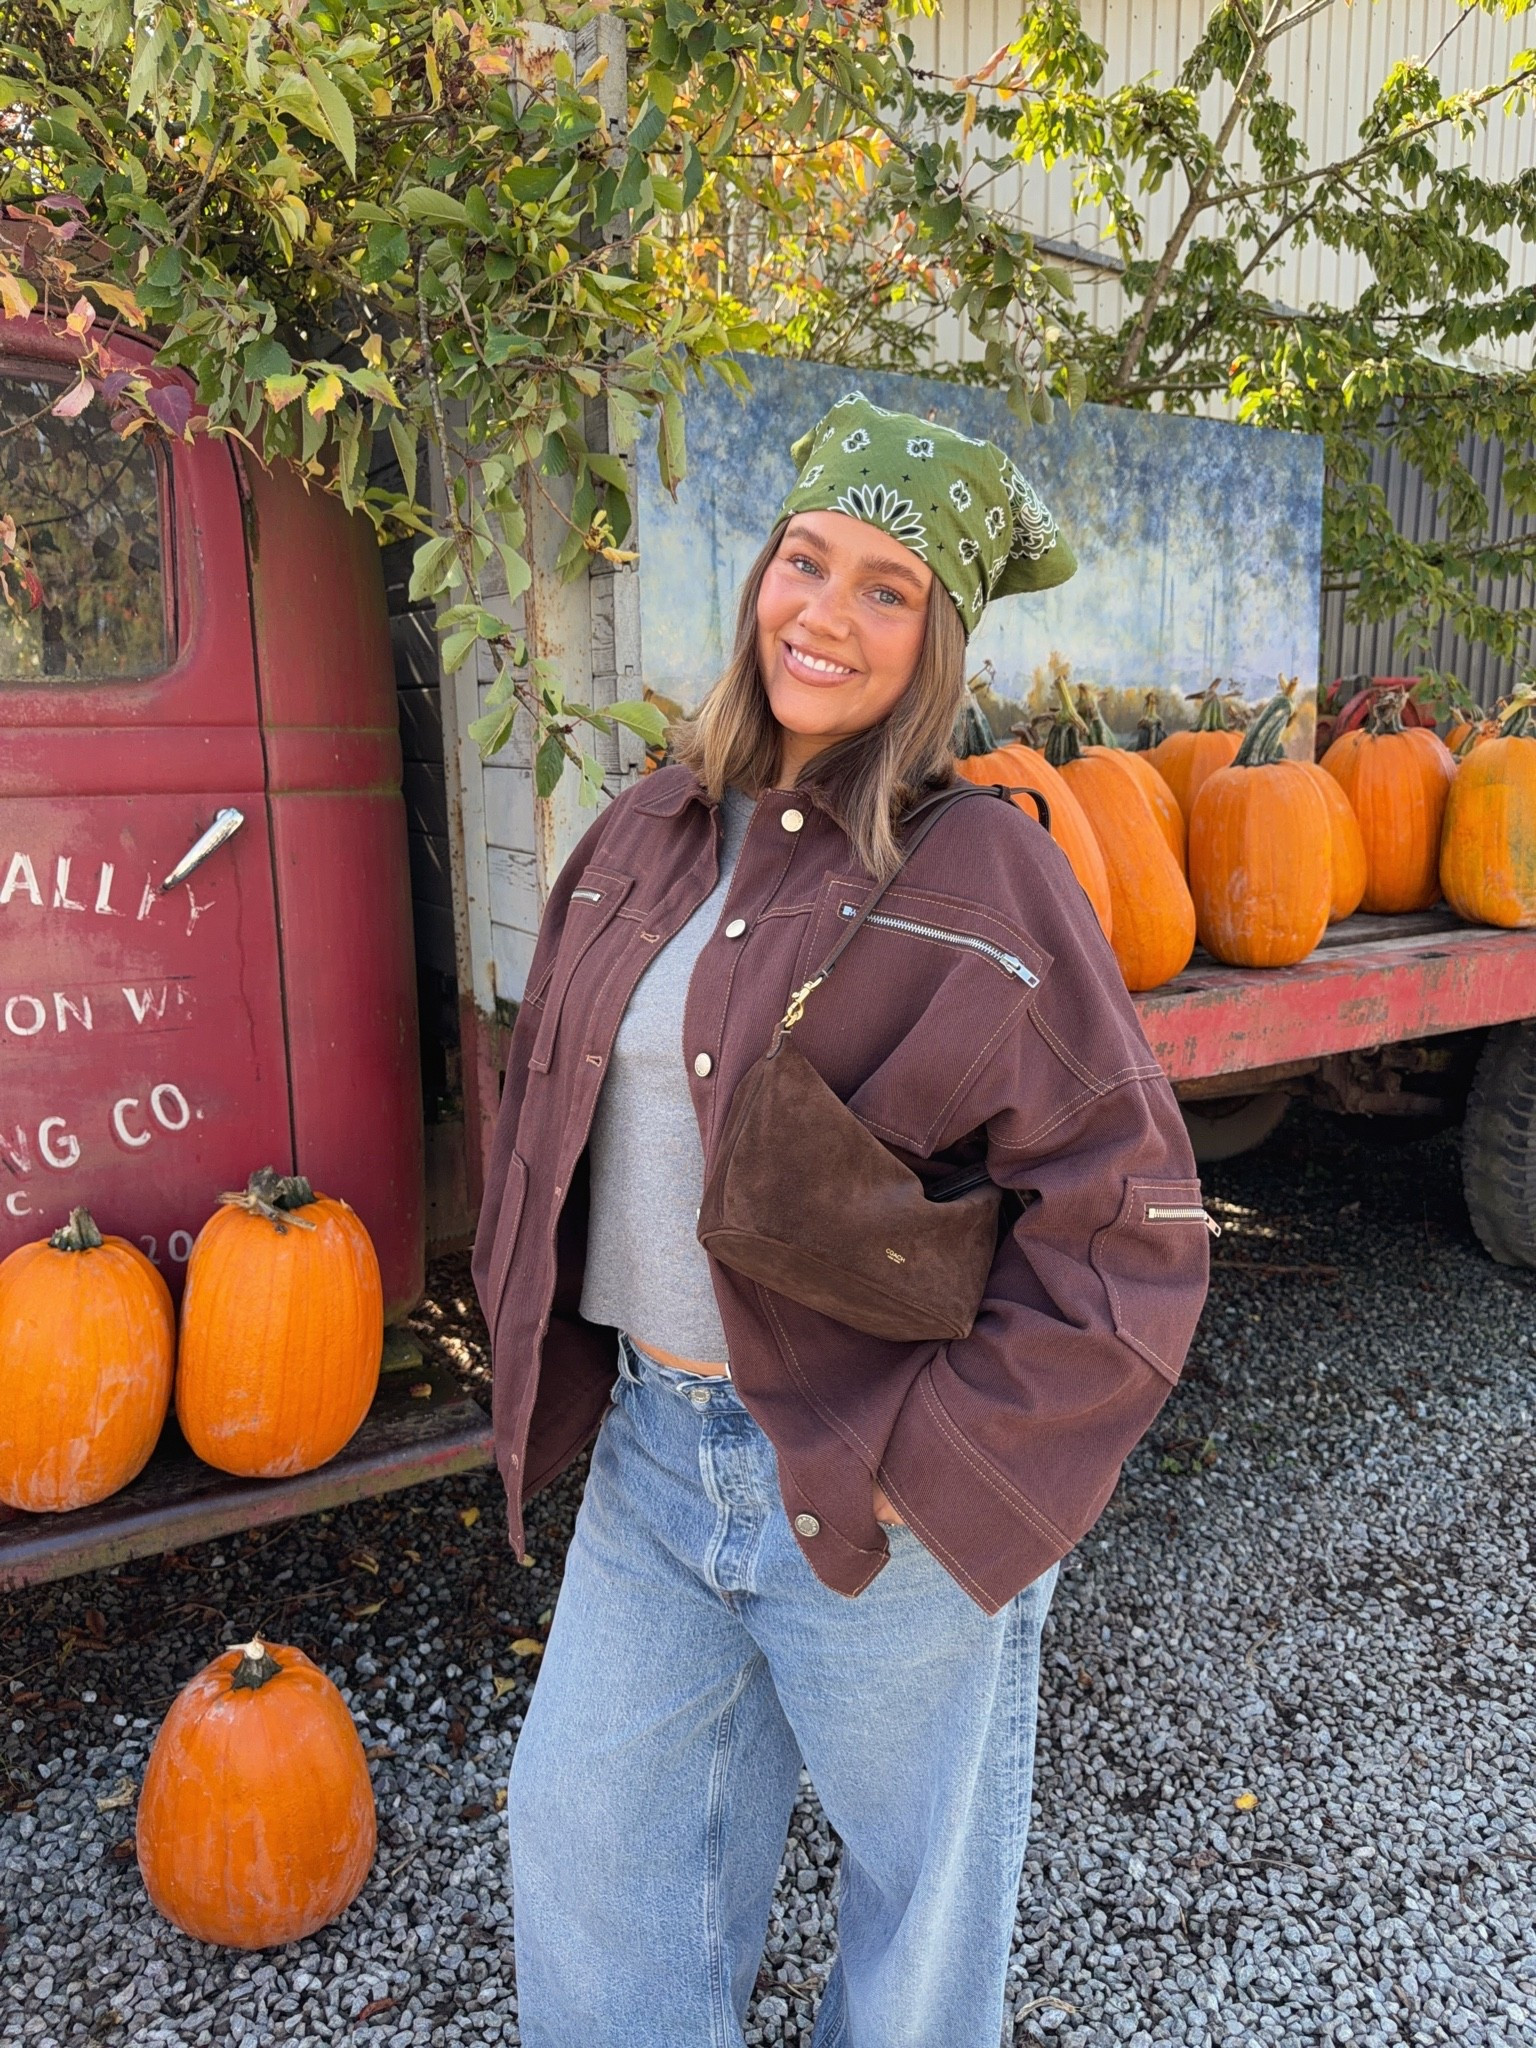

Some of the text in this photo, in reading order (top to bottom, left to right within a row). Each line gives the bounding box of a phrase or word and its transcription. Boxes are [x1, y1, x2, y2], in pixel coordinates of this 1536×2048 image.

[5, 993, 93, 1036] ON
[113, 1083, 204, 1147] CO.
[886, 1248, 905, 1263] COACH
